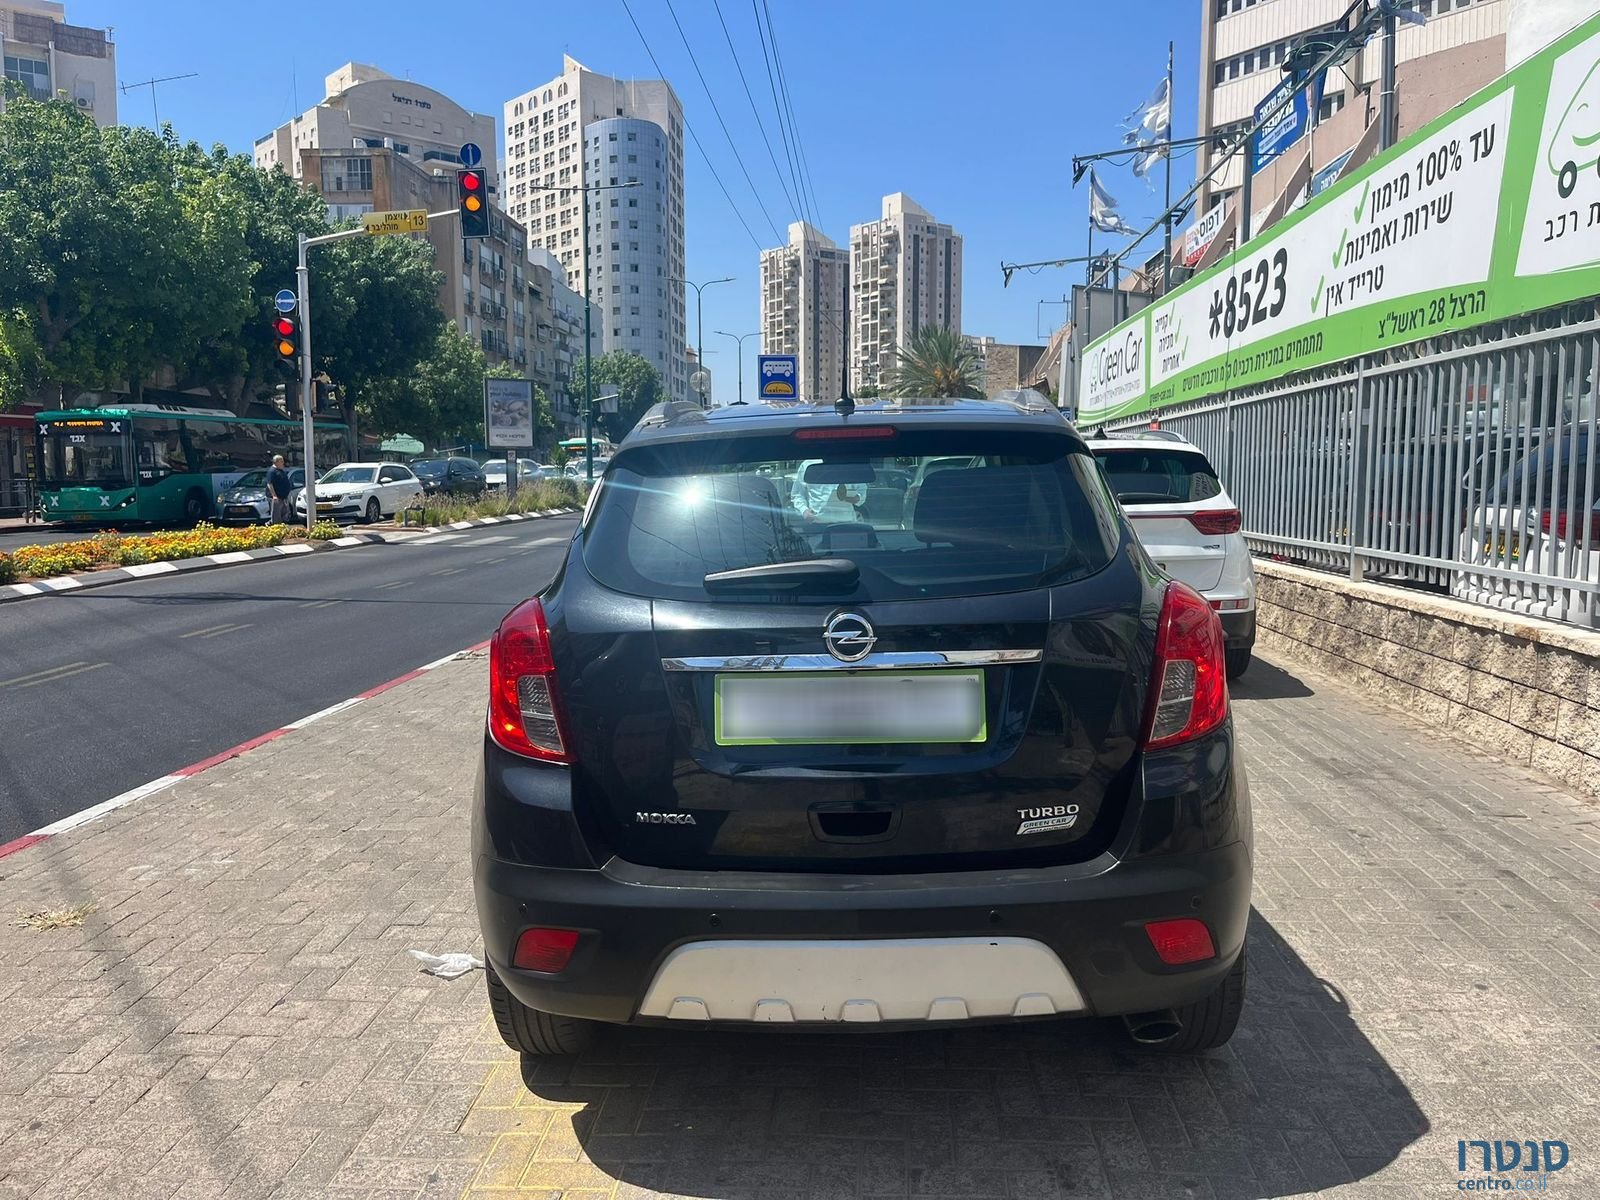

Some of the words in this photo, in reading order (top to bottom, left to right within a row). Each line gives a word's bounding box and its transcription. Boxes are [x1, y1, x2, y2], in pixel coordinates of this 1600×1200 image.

[1470, 123, 1496, 162] עד
[1416, 139, 1462, 191] 100%
[1370, 172, 1409, 224] מימון
[384, 213, 403, 223] ויצמן
[413, 215, 424, 226] 13
[1200, 210, 1219, 237] דפוס
[1401, 191, 1454, 241] שירות
[1544, 210, 1578, 242] רכב
[1344, 218, 1398, 267] ואמינות
[1348, 264, 1384, 300] טרייד
[1325, 281, 1344, 317] אין
[1428, 297, 1446, 326] 28
[1450, 289, 1486, 319] הרצל
[1099, 347, 1123, 386] Green
[1124, 331, 1143, 374] Car
[1254, 345, 1284, 372] במכירת
[1286, 331, 1323, 361] מתמחים
[636, 811, 697, 825] MOKKA
[1017, 804, 1080, 819] TURBO
[1023, 820, 1050, 829] GREEN
